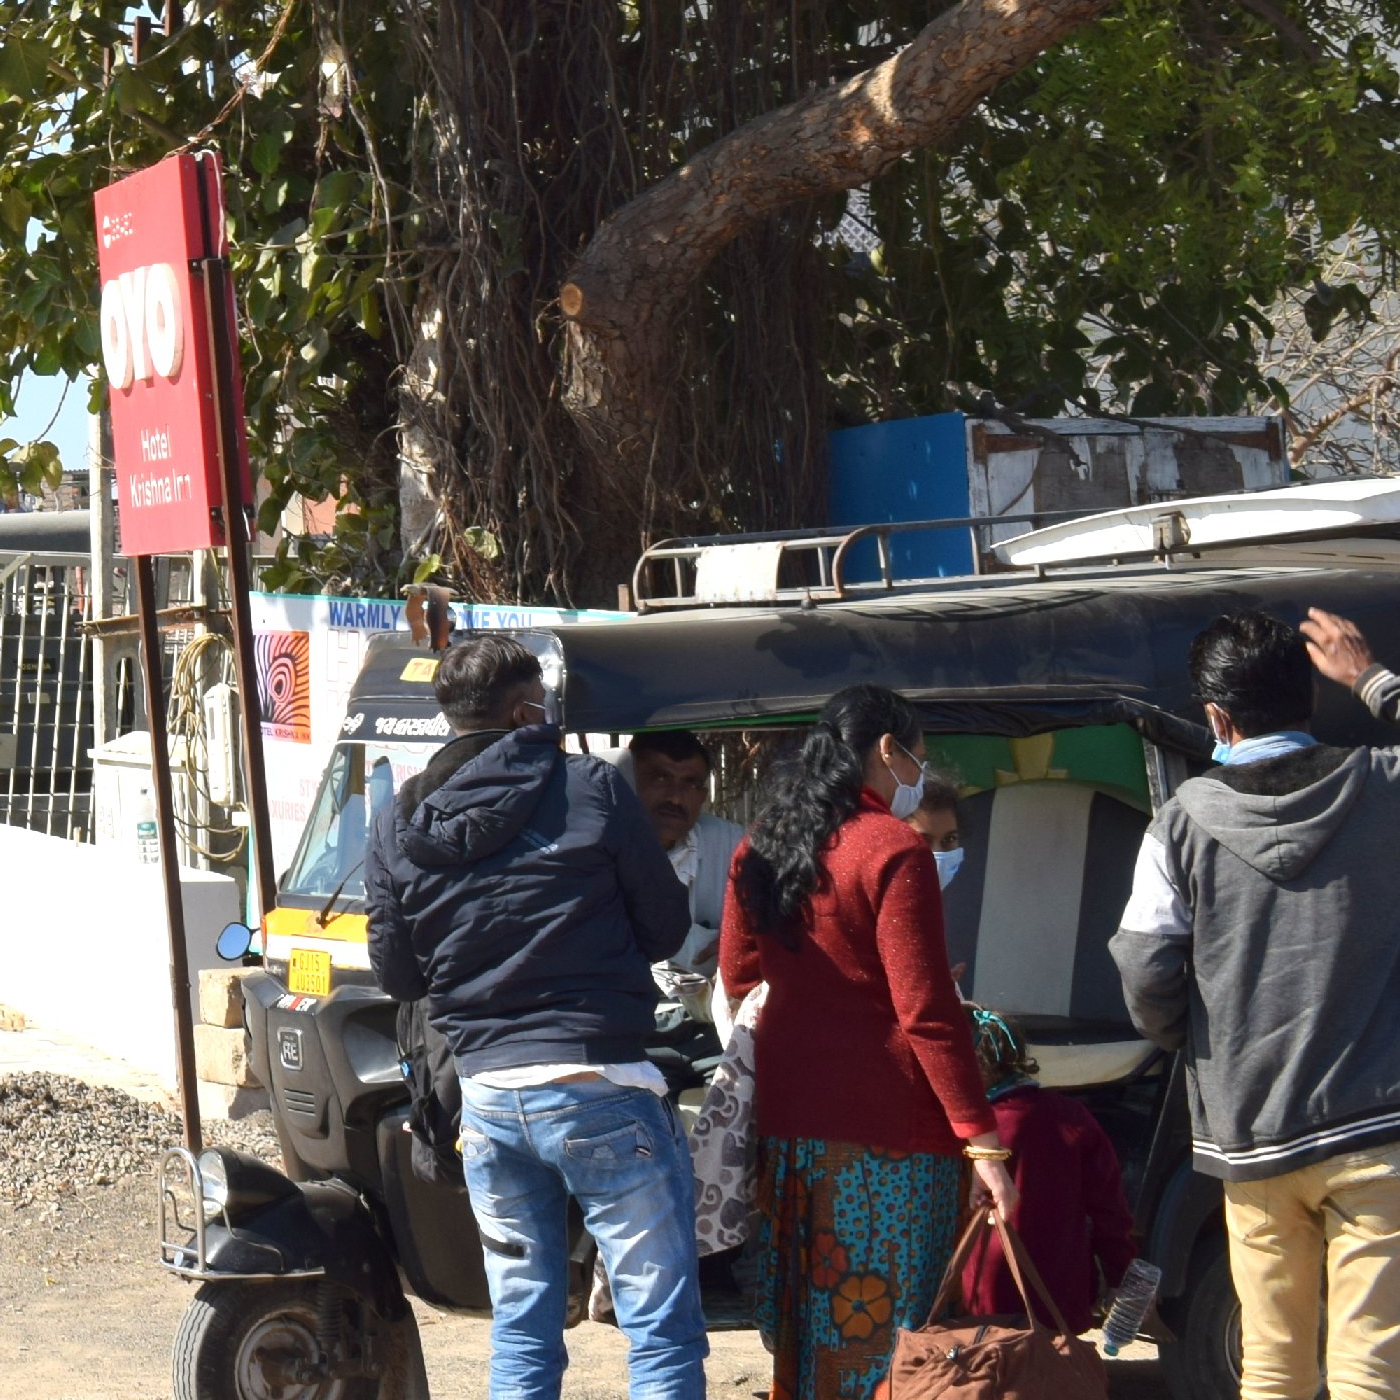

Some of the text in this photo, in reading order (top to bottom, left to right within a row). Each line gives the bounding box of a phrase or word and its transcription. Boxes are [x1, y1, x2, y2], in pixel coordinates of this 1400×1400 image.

[100, 262, 181, 390] OYO
[140, 424, 172, 462] Hotel
[129, 468, 192, 508] Krishna Inn
[328, 601, 401, 630] WARMLY
[298, 952, 320, 971] GJ15
[282, 1040, 299, 1061] RE
